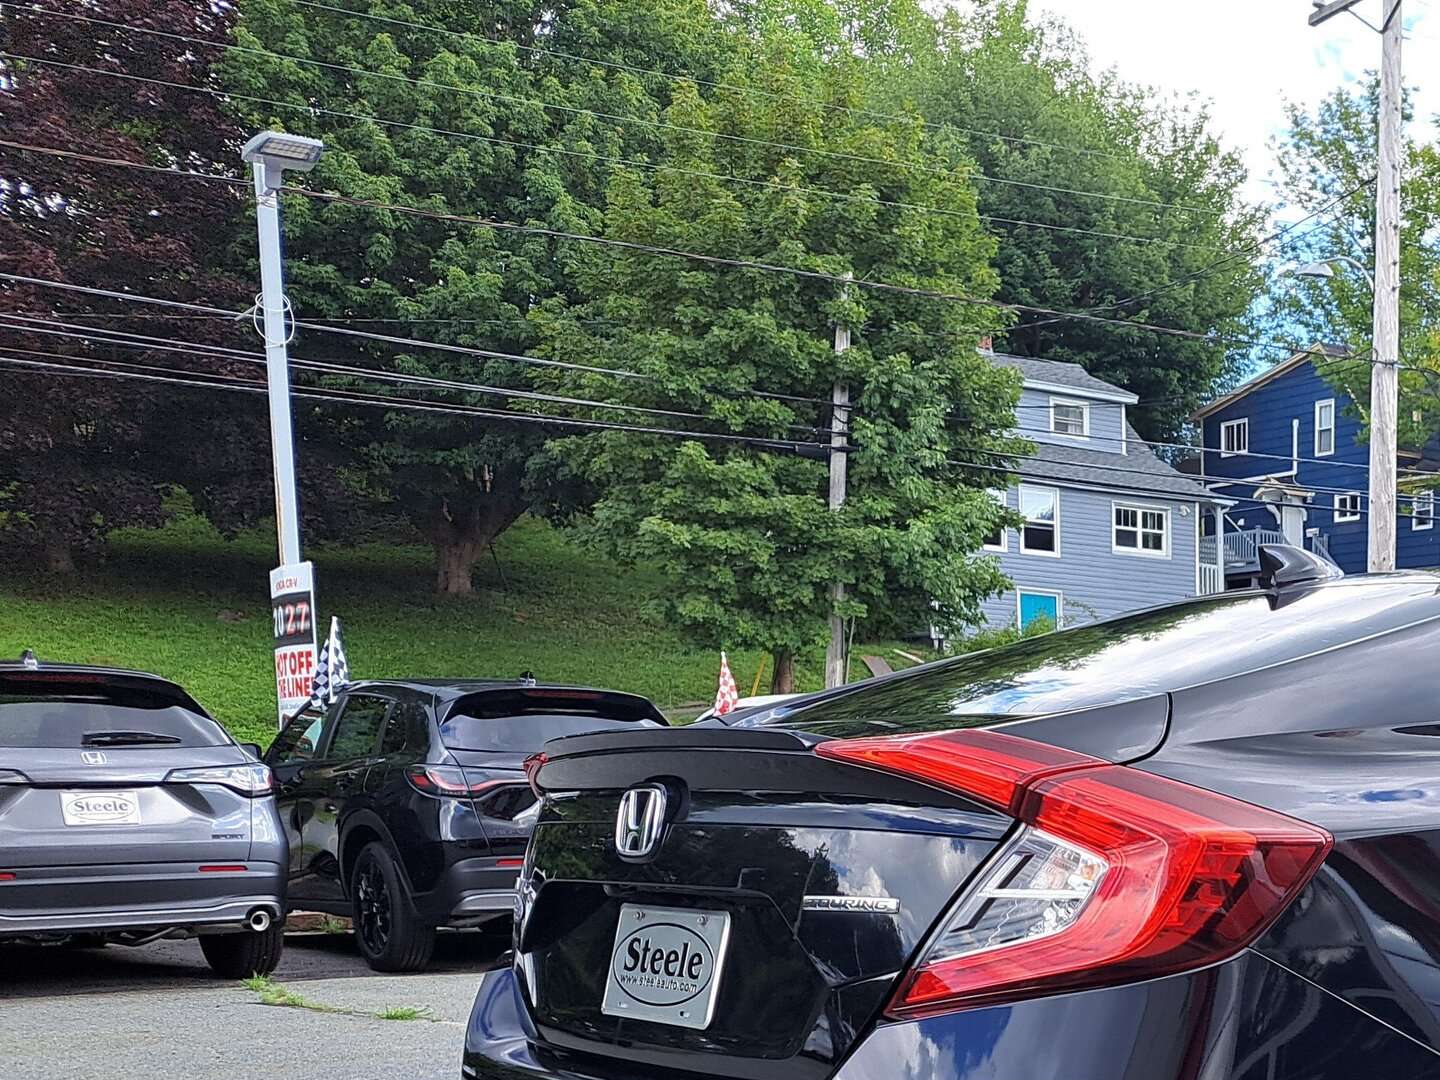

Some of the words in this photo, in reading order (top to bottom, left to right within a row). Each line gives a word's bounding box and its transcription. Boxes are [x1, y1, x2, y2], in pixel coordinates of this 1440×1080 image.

[289, 650, 313, 675] OFF
[74, 800, 129, 812] Steele
[211, 833, 246, 841] SPORT
[623, 937, 705, 980] Steele
[619, 974, 708, 993] www.steeleauto.com
